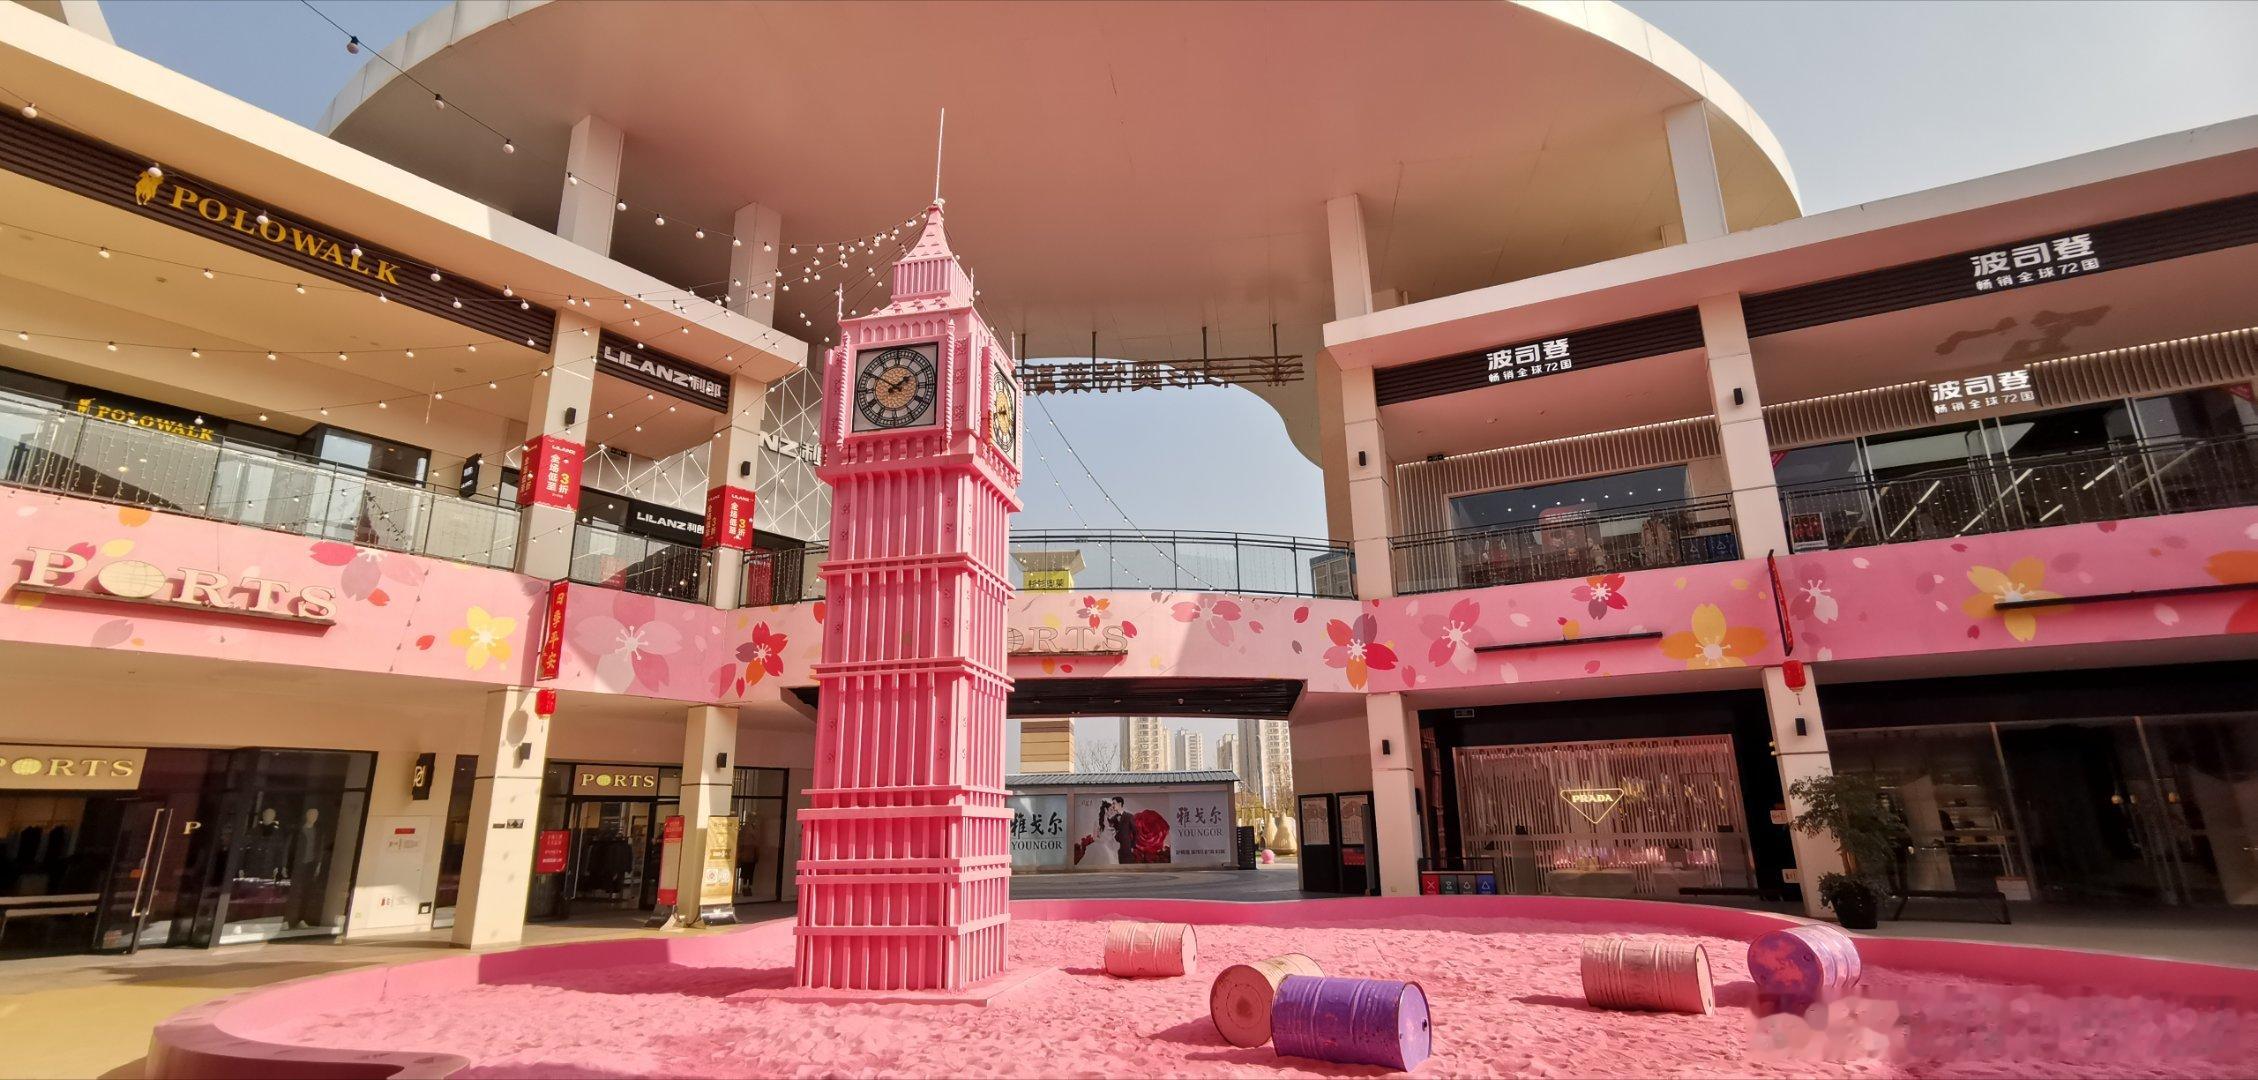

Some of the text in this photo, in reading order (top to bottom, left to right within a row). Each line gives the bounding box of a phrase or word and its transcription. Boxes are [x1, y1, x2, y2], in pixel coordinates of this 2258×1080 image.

[170, 184, 401, 285] POLOWALK
[1970, 233, 2095, 277] 波司登
[1975, 257, 2100, 291] 畅销全球72国
[1486, 338, 1570, 371] 波司登
[1488, 358, 1572, 383] 畅销全球72国
[1929, 369, 2031, 402] 波司登
[1934, 391, 2035, 414] 畅销全球72国
[96, 405, 216, 441] POLOWALK
[20, 546, 338, 619] PORTS
[581, 773, 655, 788] PORTS
[1571, 794, 1614, 803] PRADA
[1010, 811, 1063, 839] 雅戈尔
[1176, 806, 1222, 828] 雅戈尔
[1011, 840, 1063, 850] YOUNGOR
[1177, 829, 1223, 838] YOUNGOR
